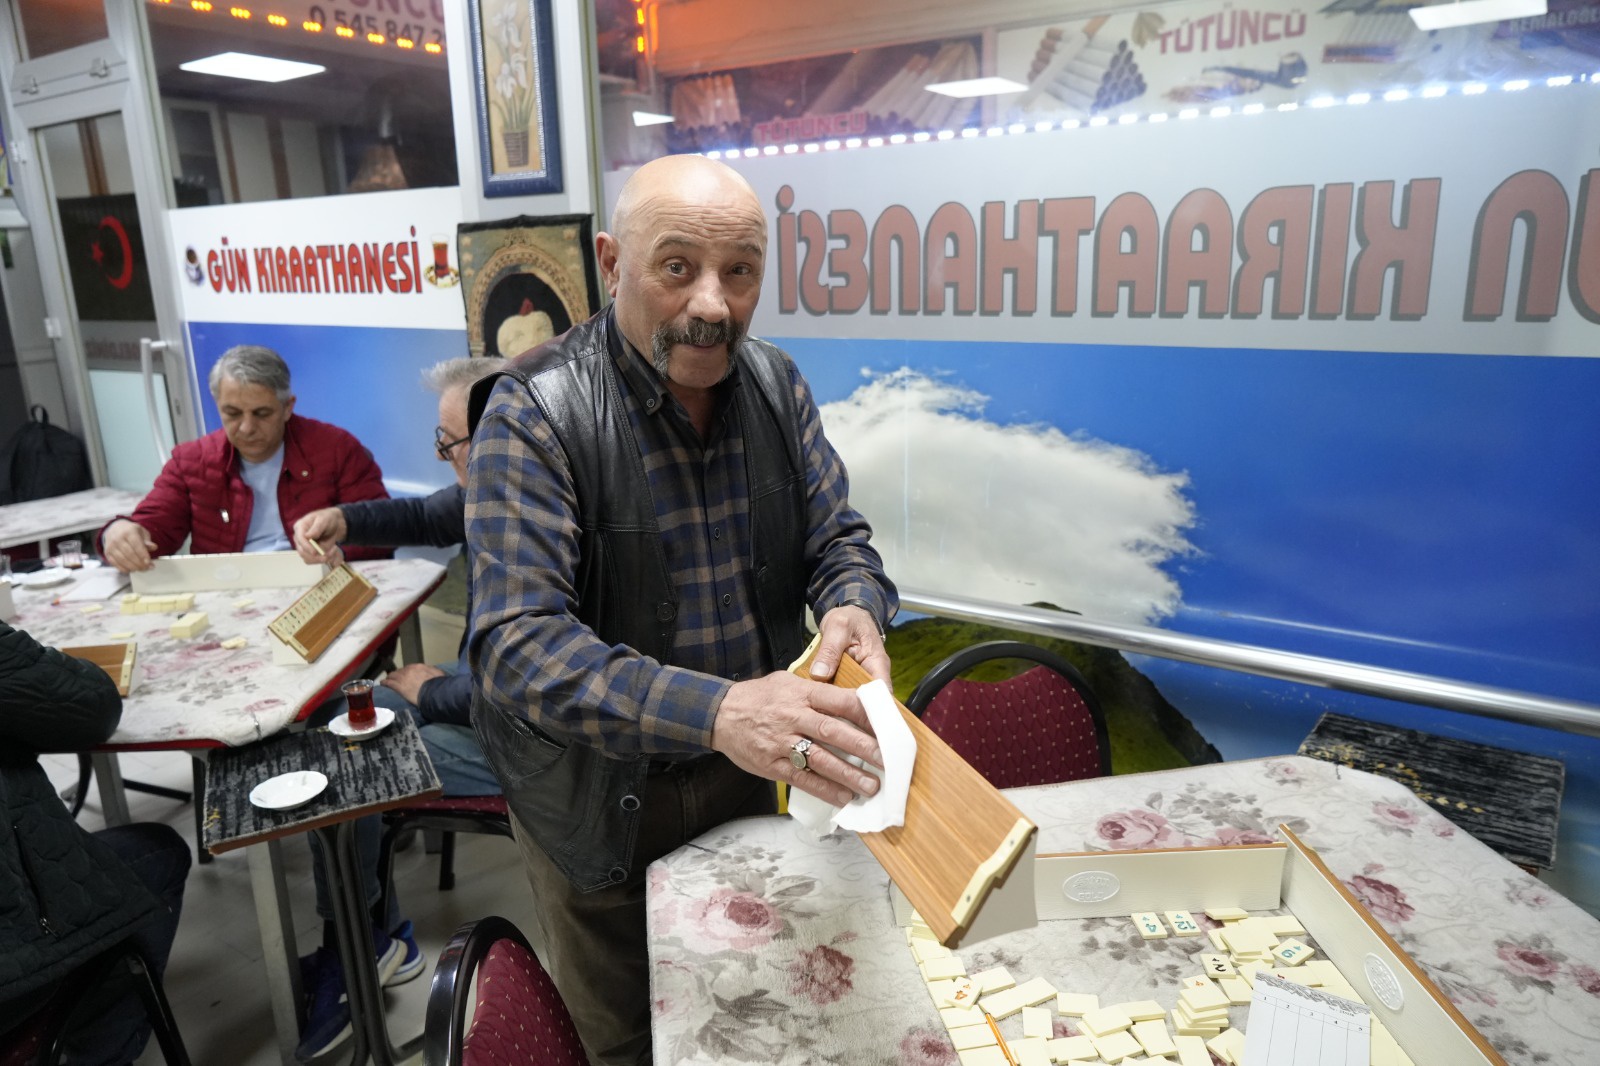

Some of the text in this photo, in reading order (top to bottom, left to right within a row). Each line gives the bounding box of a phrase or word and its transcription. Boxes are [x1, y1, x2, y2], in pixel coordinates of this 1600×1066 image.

[1154, 3, 1308, 54] TÜTÜNCÜ
[207, 225, 423, 295] GÜN KIRAATHANESİ
[1174, 920, 1197, 931] 12
